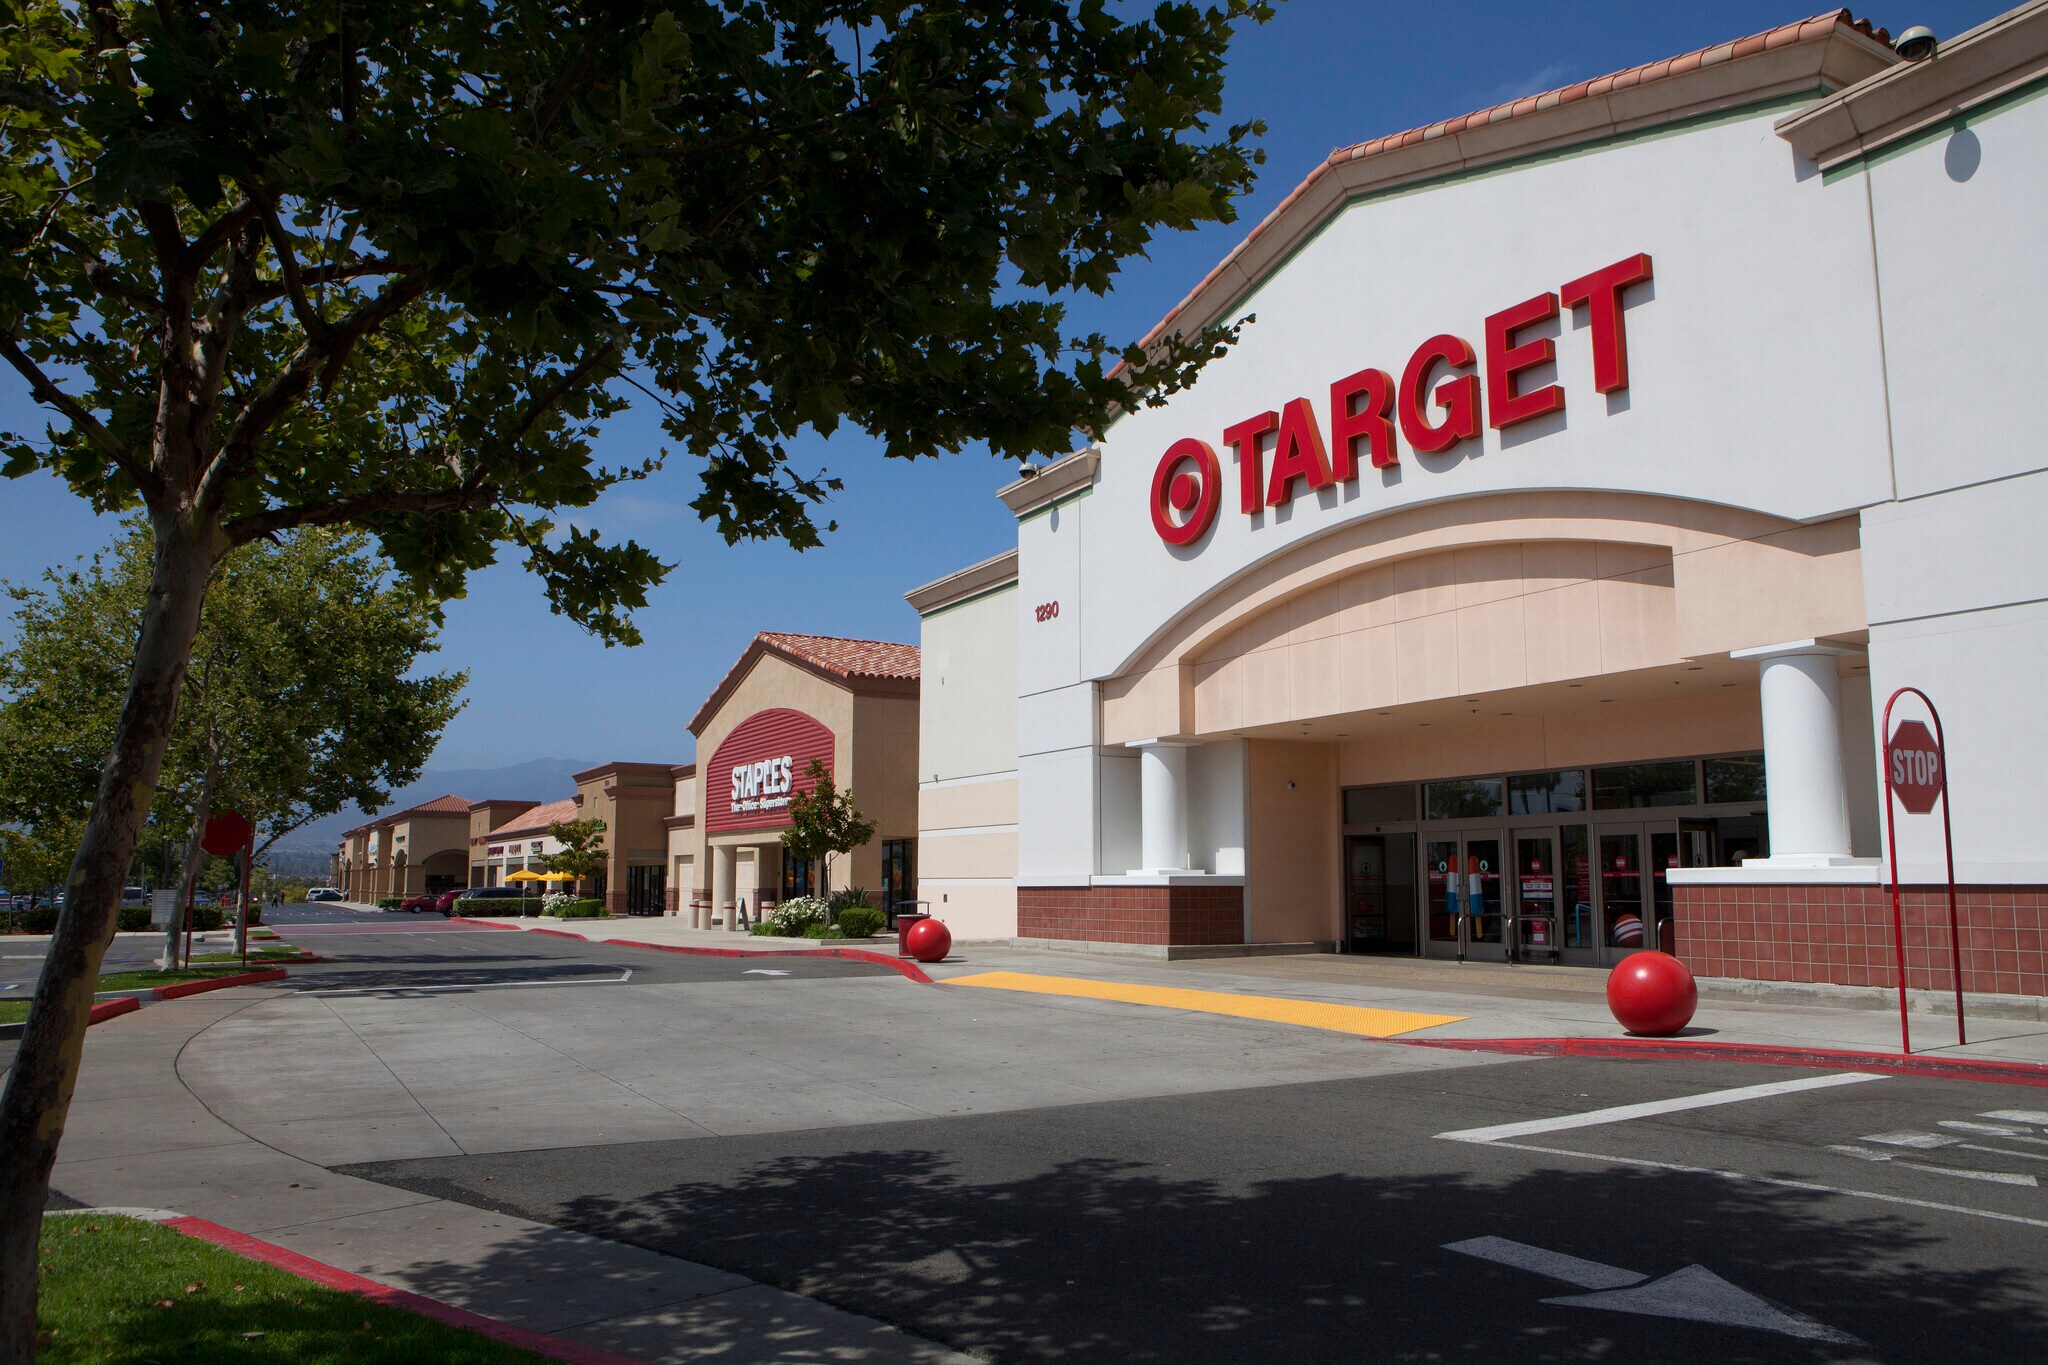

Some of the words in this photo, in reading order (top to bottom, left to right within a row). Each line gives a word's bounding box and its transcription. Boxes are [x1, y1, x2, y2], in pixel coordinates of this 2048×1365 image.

[1223, 252, 1653, 516] TARGET
[1035, 600, 1059, 623] 1290
[731, 756, 793, 800] STAPLES
[1893, 748, 1938, 786] STOP
[731, 802, 741, 813] The
